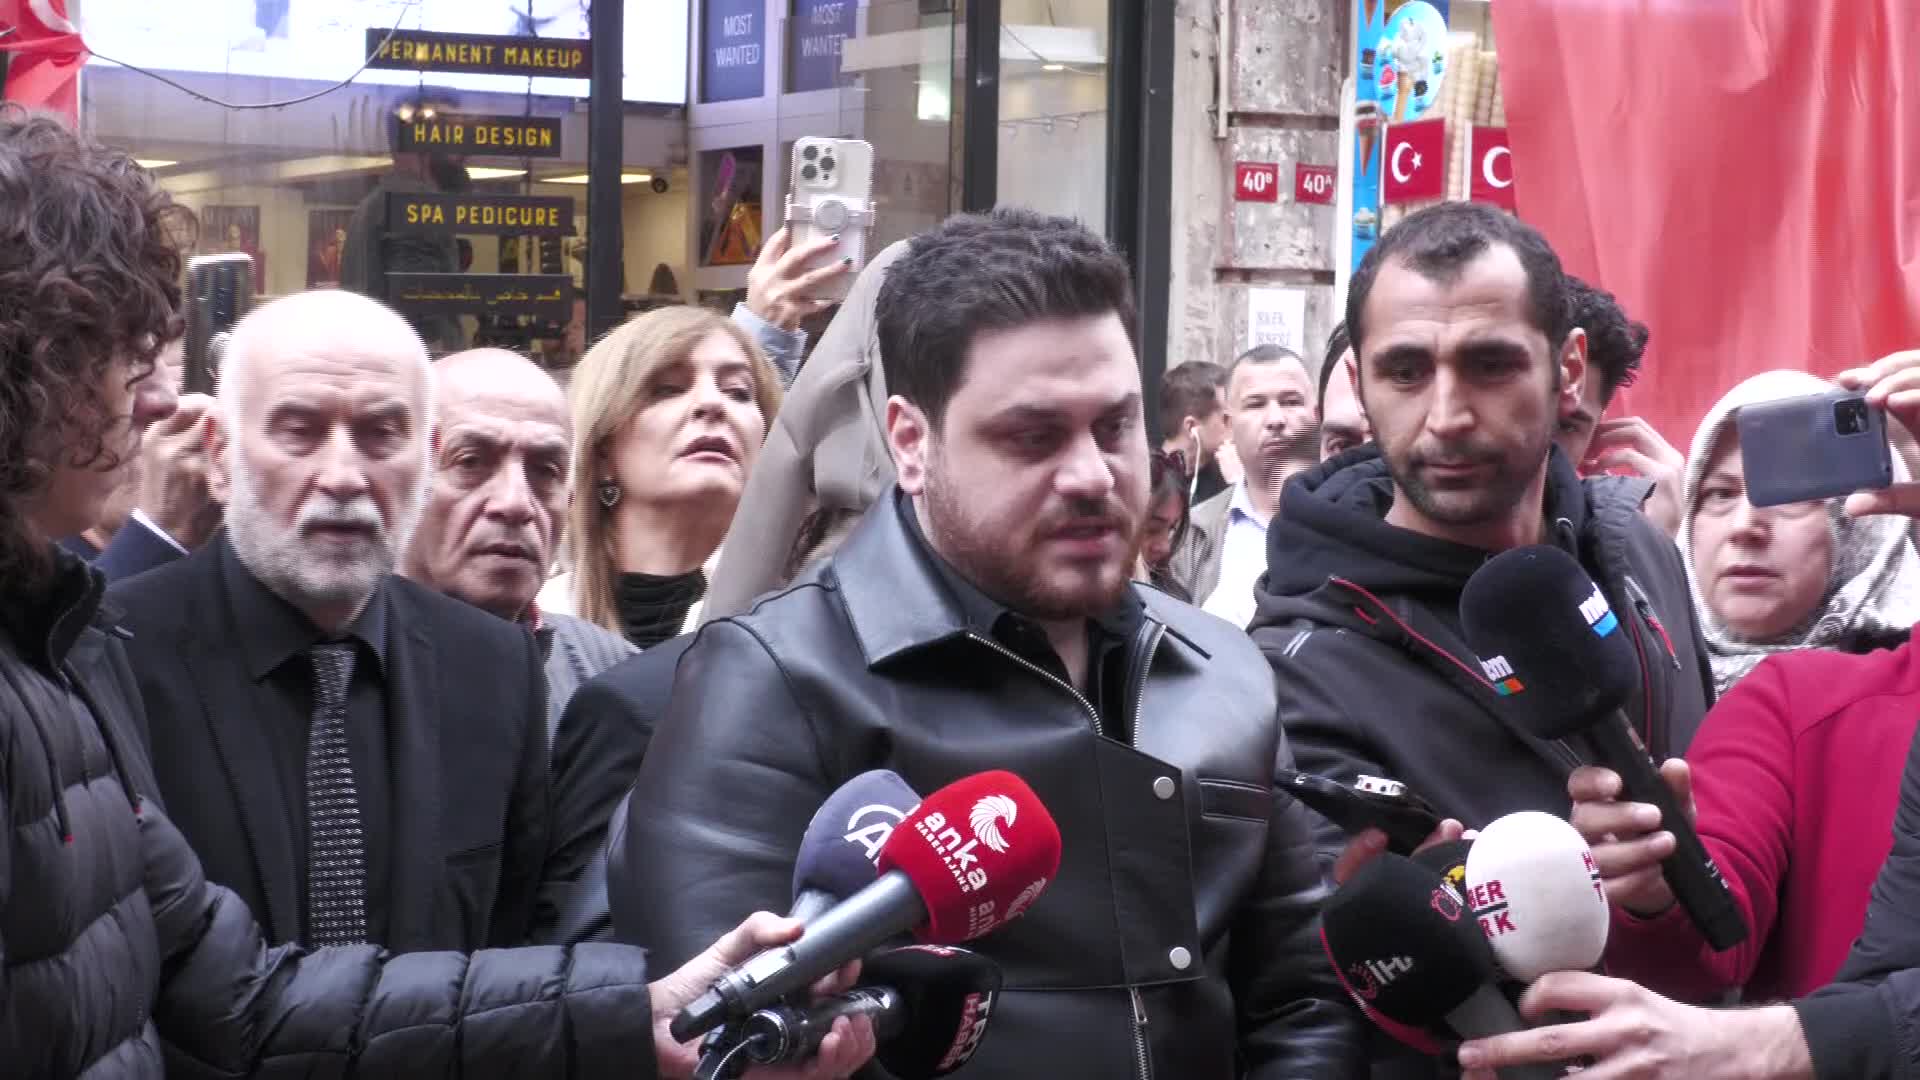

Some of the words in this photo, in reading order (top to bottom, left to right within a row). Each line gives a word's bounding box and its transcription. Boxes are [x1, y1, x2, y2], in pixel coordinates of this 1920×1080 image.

[723, 13, 753, 36] MOST
[811, 2, 844, 24] MOST
[379, 38, 496, 65] PERMANENT
[503, 47, 583, 69] MAKEUP
[715, 43, 761, 67] WANTED
[414, 124, 465, 144] HAIR
[475, 126, 553, 146] DESIGN
[407, 204, 445, 224] SPA
[456, 206, 560, 226] PEDICURE
[914, 821, 945, 855] HABER
[924, 812, 988, 891] anka
